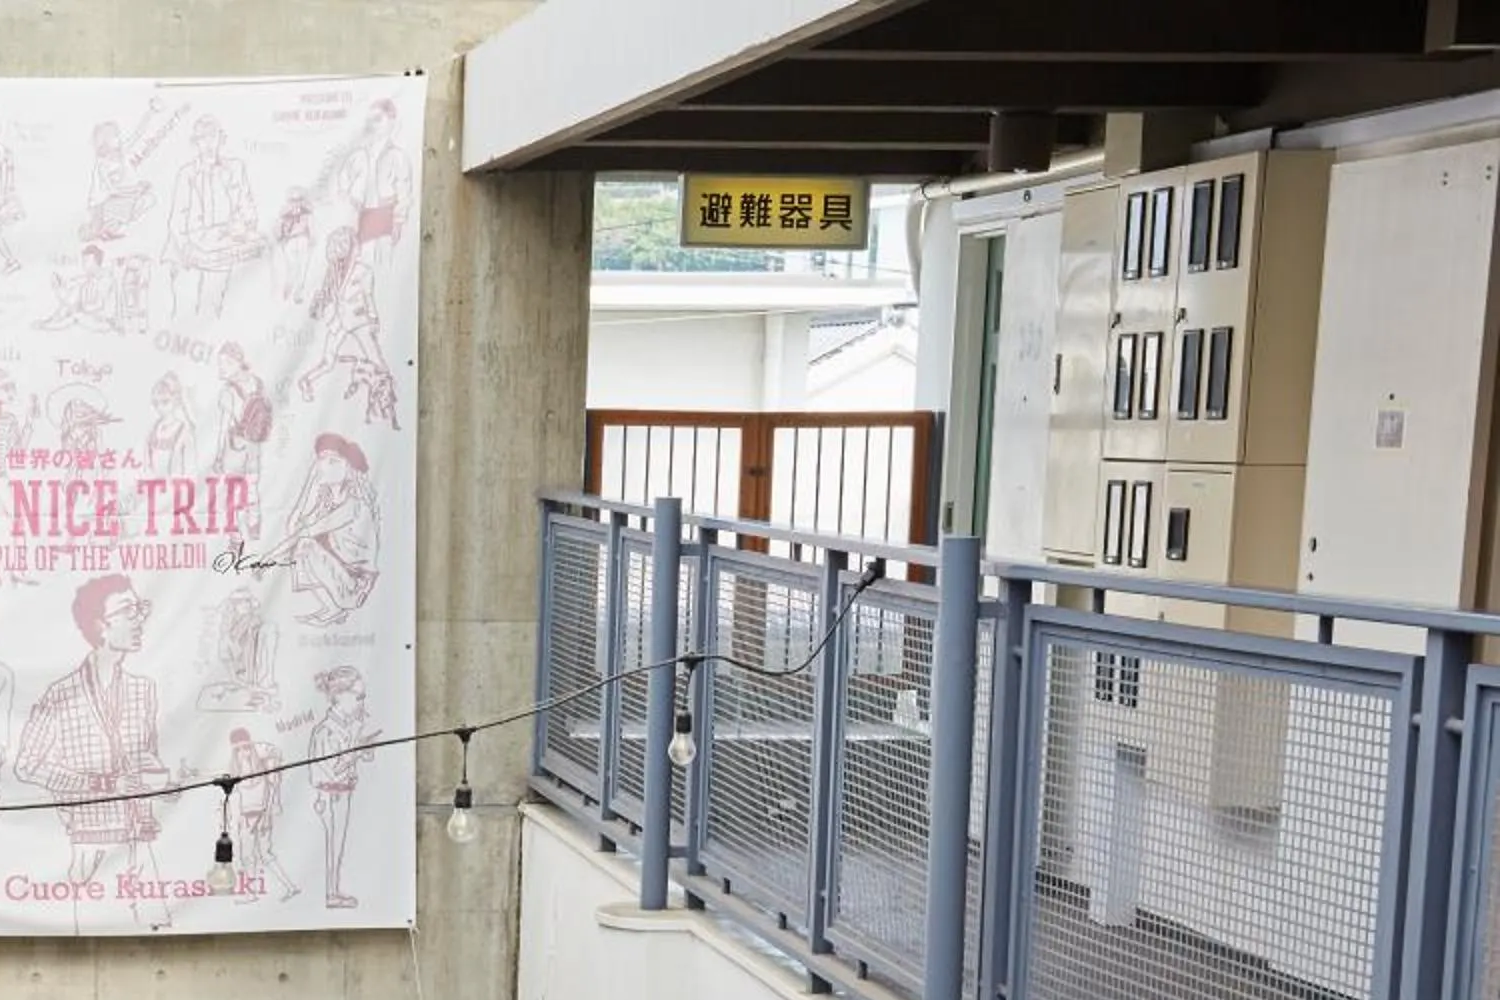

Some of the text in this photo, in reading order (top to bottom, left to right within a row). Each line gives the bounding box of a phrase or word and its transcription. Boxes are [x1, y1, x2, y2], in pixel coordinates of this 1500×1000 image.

[699, 192, 853, 231] 避難器具
[153, 329, 214, 365] OMG!
[56, 358, 113, 383] Tokyo
[9, 479, 120, 538] NICE
[137, 475, 250, 538] TRIP
[35, 545, 61, 571] OF
[71, 544, 110, 571] THE
[4, 873, 105, 901] Cuore
[115, 868, 268, 899] Kuraski
